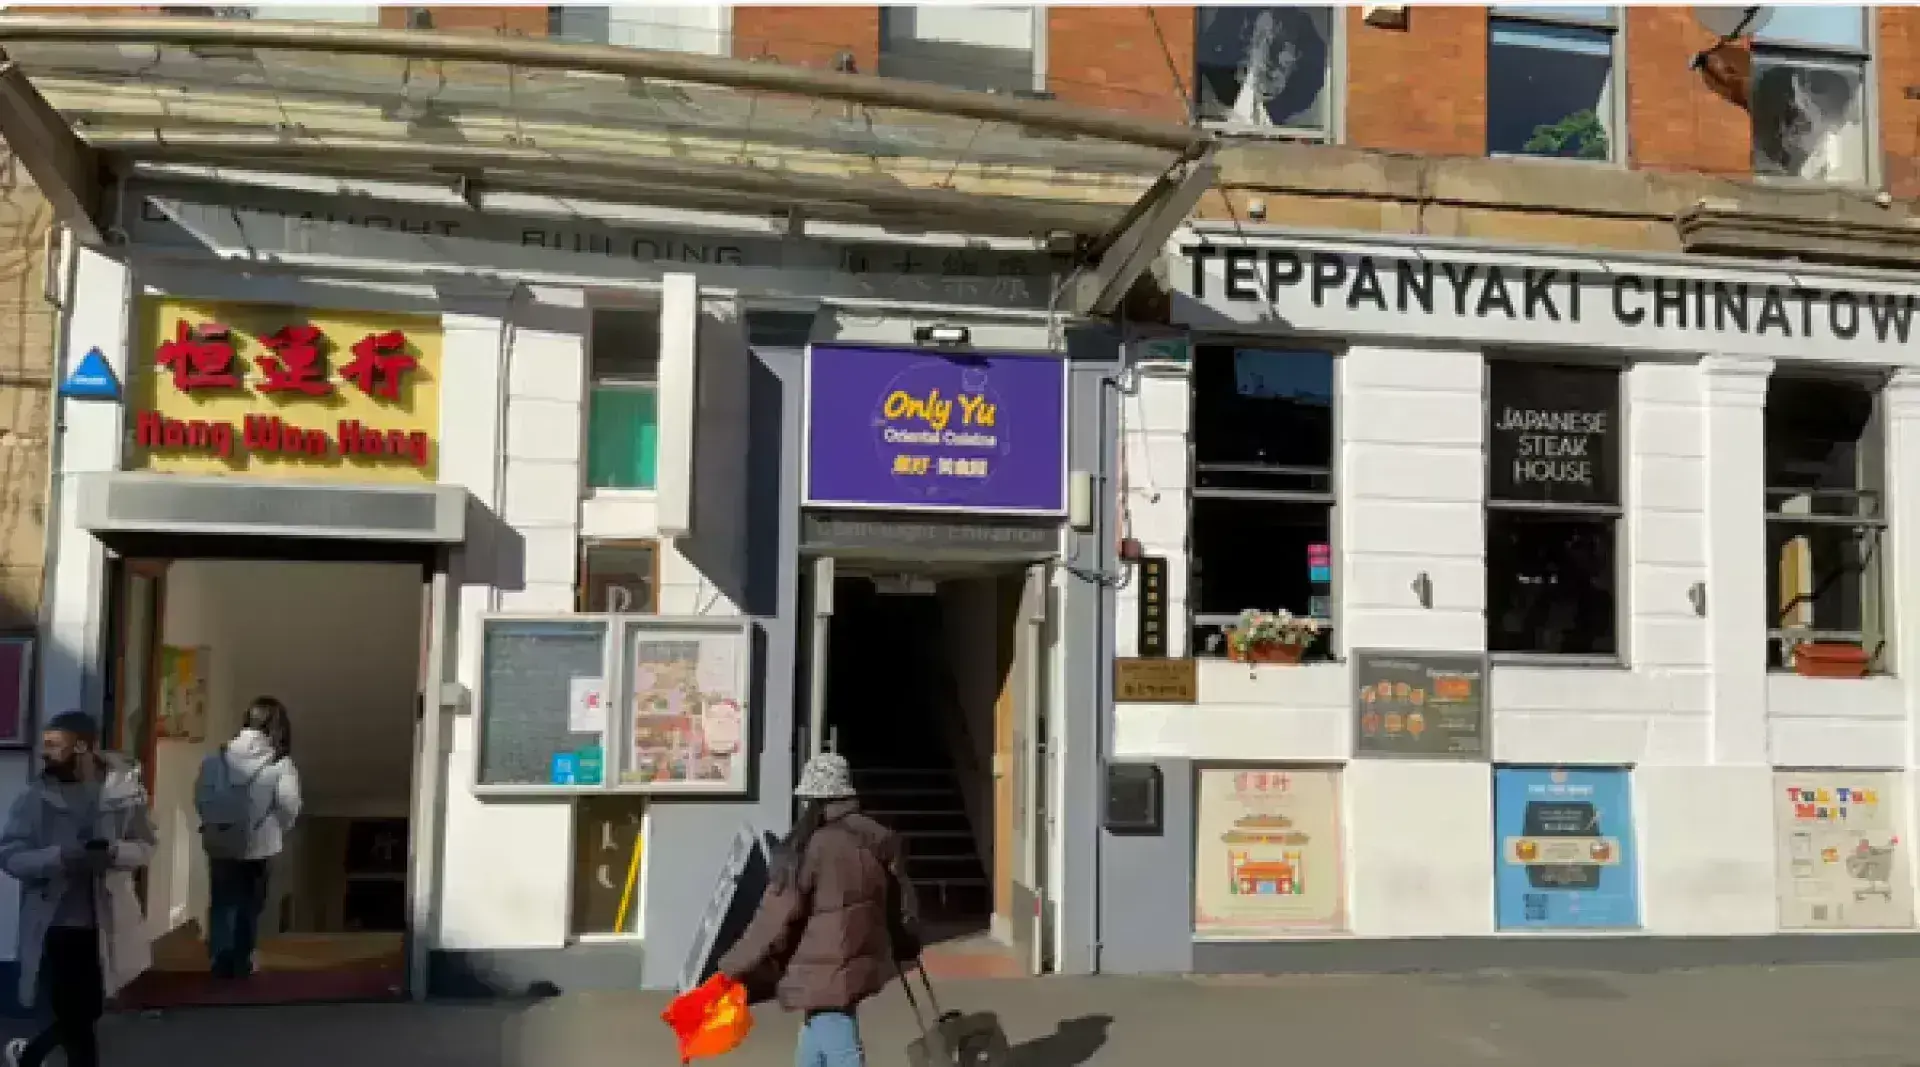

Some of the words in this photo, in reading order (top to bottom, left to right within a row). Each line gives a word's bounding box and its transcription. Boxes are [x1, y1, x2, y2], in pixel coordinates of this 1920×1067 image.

[1182, 244, 1582, 323] TEPPANYAKI
[884, 387, 953, 431] Only
[957, 393, 997, 427] Yu
[1496, 406, 1608, 434] JAPANESE
[1517, 434, 1589, 457] STEAK
[1512, 459, 1593, 485] HOUSE
